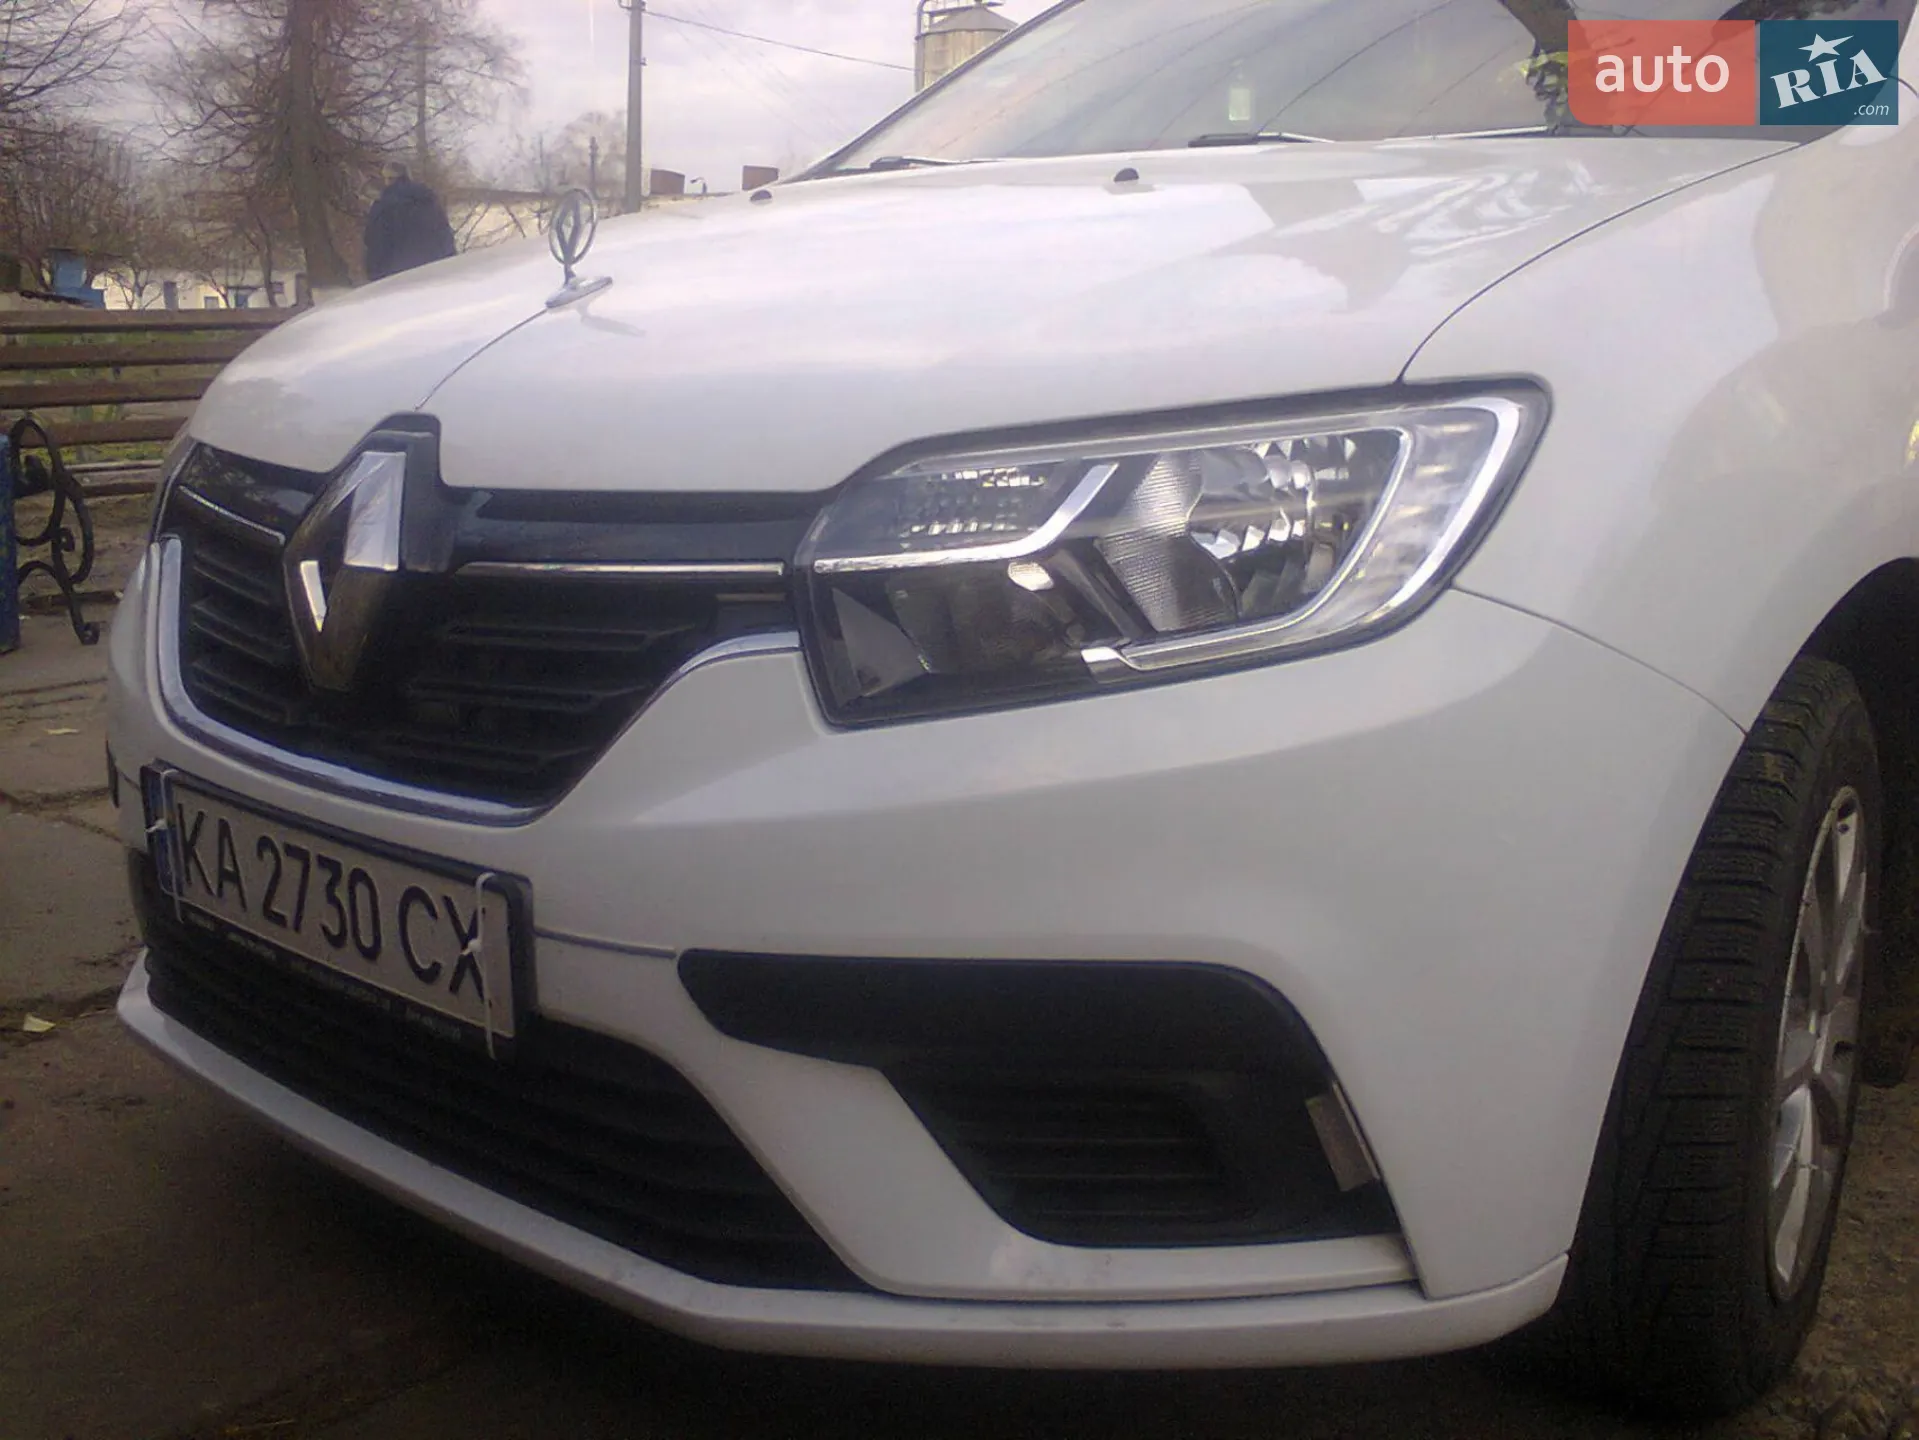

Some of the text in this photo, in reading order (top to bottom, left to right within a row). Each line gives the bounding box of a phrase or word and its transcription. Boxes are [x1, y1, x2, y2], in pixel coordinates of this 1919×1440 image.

[178, 803, 247, 912] KA
[256, 835, 383, 961] 2730
[400, 885, 492, 1009] CX
